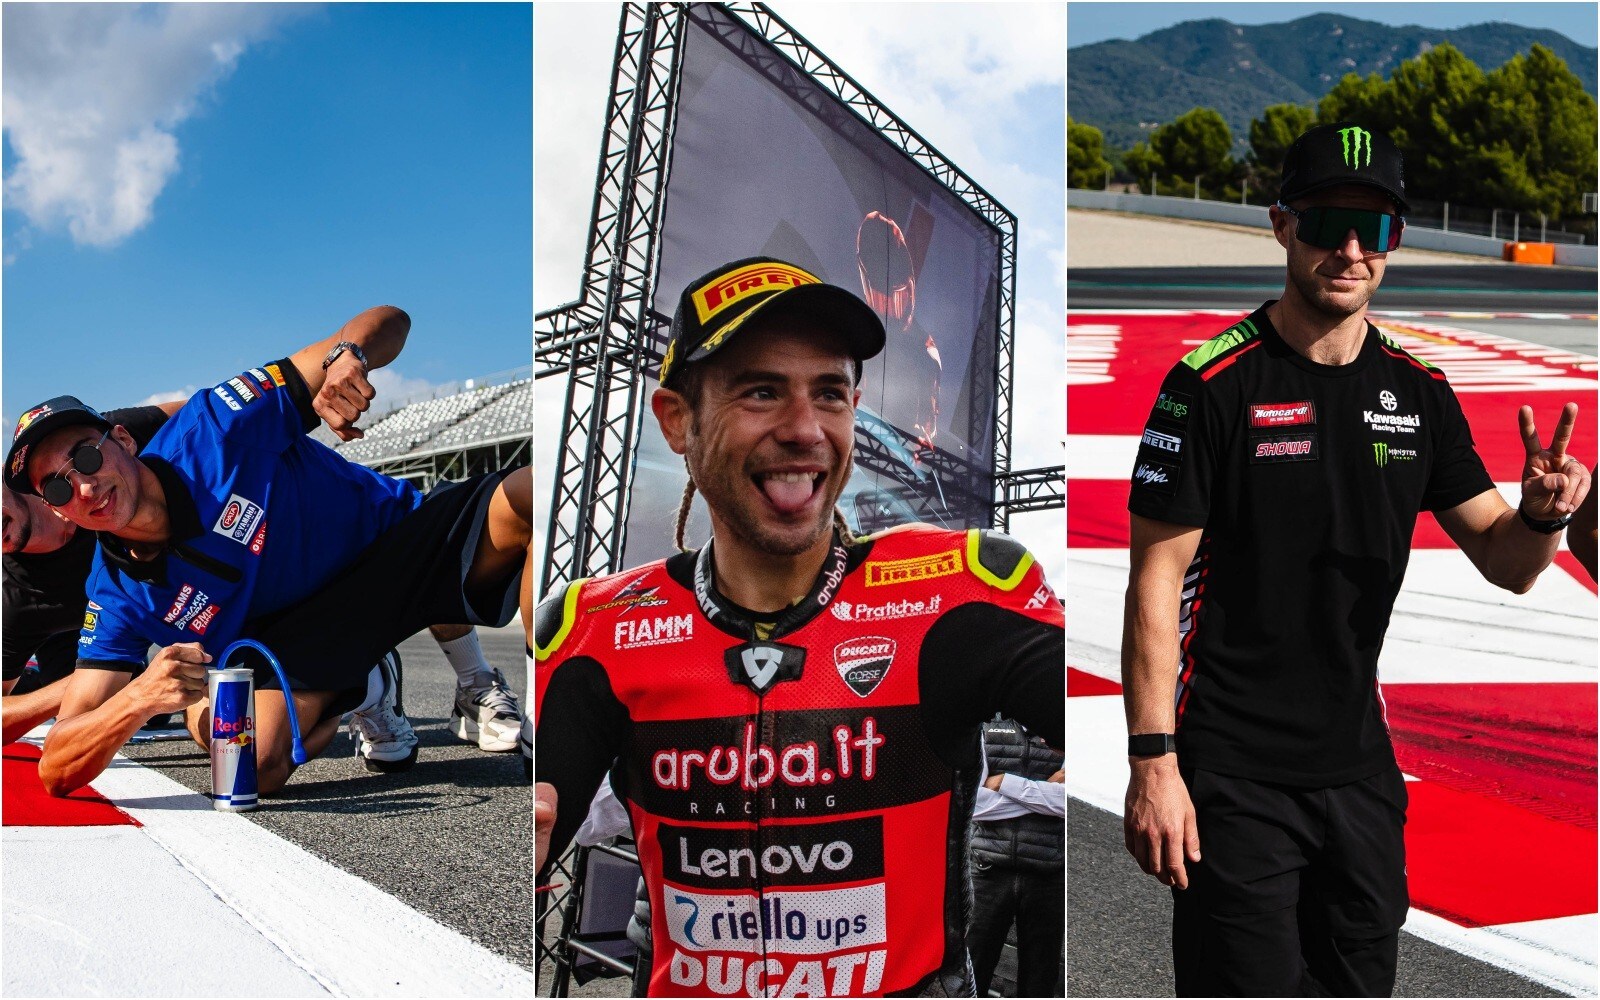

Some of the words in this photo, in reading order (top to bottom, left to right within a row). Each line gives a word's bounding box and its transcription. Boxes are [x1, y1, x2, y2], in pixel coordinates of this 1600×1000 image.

[213, 386, 243, 411] GYTR
[1363, 410, 1421, 427] Kawasaki
[1371, 423, 1396, 434] Racing
[1395, 425, 1416, 434] Team
[1255, 440, 1312, 457] SHOWA
[1388, 448, 1418, 457] MONSTER
[1135, 463, 1169, 485] Ninja
[224, 507, 238, 525] PATA
[238, 506, 256, 531] YAMAHA
[817, 545, 848, 606] aruba.it
[871, 554, 955, 583] PIRELLI
[694, 561, 721, 620] DUCATI
[163, 585, 193, 624] McAMS
[586, 595, 659, 614] SCORPION
[855, 593, 942, 619] Pratiche.it
[191, 605, 213, 631] BMP
[614, 613, 693, 645] FIAMM
[840, 643, 890, 657] DUCATI
[848, 669, 881, 680] CORSE
[214, 716, 243, 732] Red
[653, 716, 886, 790] aruba.it
[689, 795, 836, 815] RACING
[679, 836, 854, 879] Lenovo
[711, 896, 807, 941] riello
[815, 913, 868, 946] ups
[670, 947, 888, 998] DUCATI
